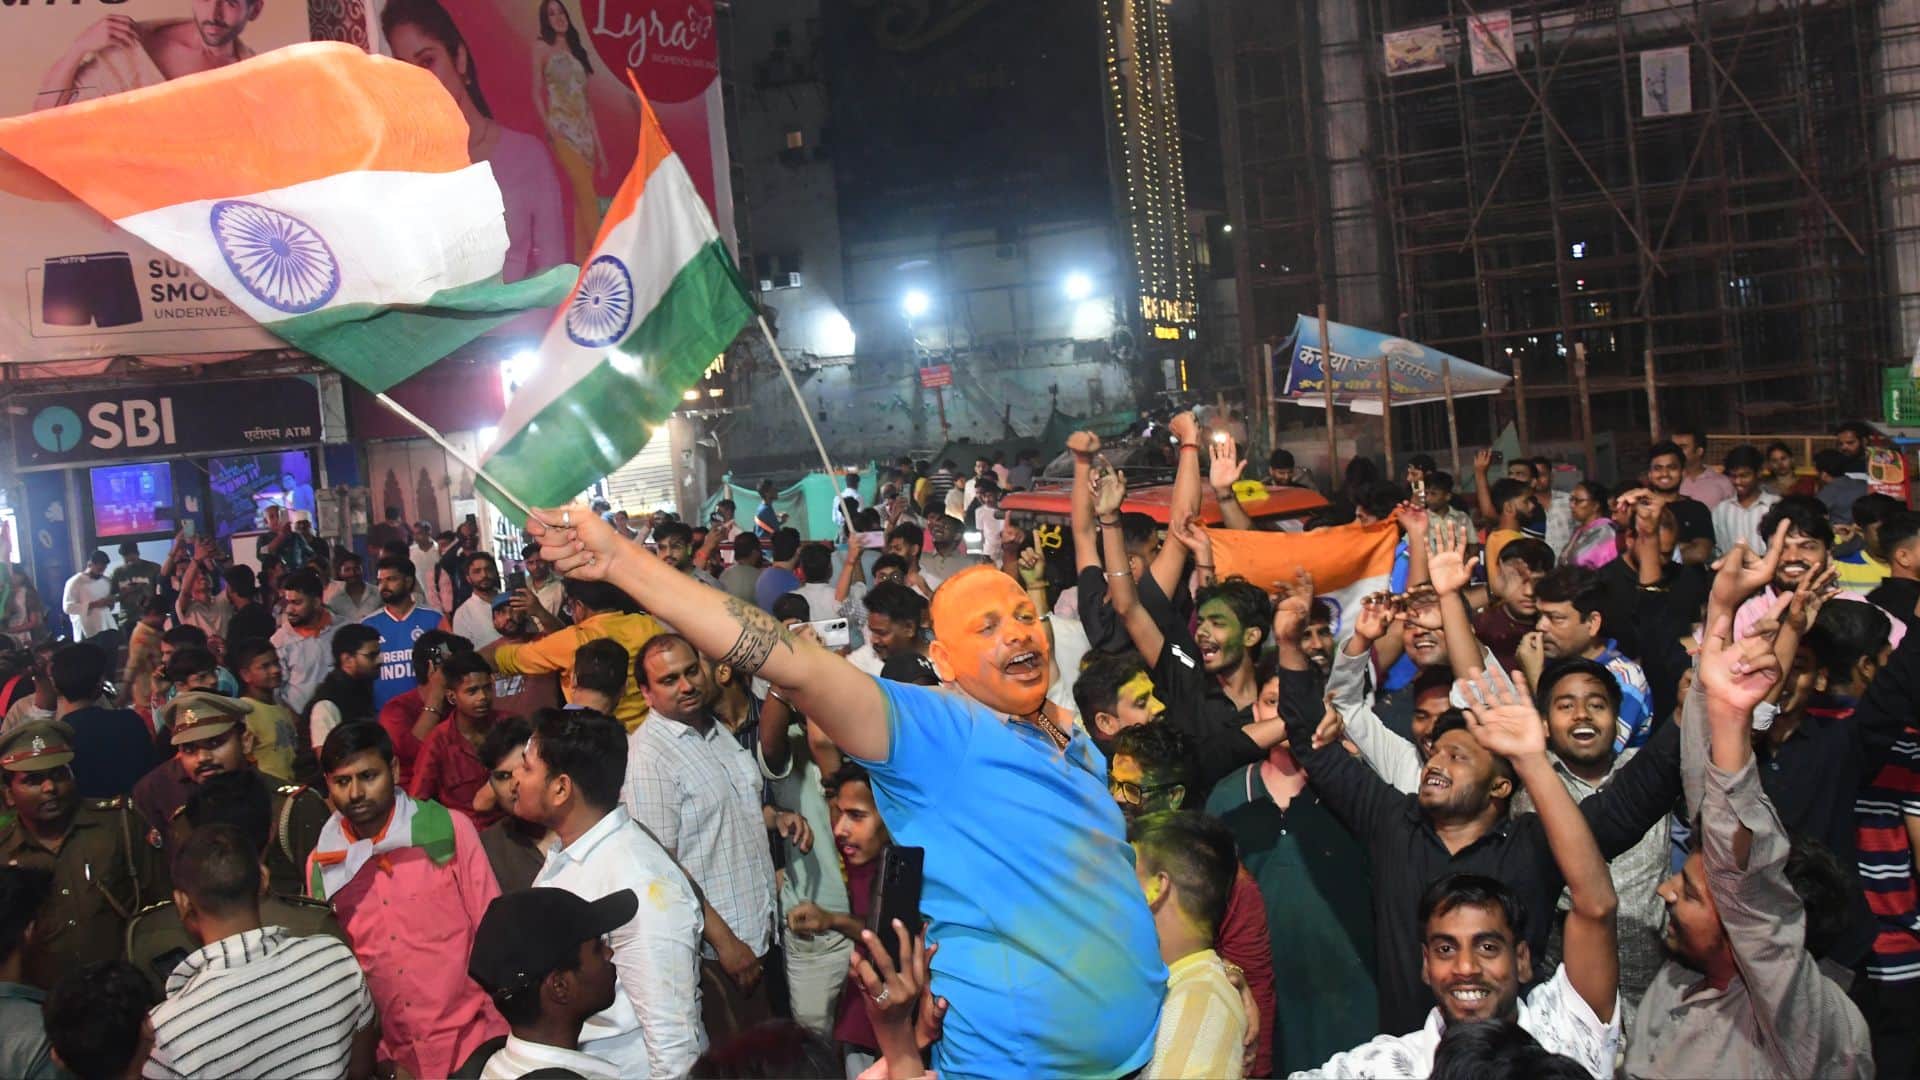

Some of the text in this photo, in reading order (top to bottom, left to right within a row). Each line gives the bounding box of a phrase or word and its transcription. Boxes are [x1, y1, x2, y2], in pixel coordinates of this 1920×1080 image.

[592, 0, 697, 67] Lyra
[89, 397, 176, 449] SBI
[285, 426, 311, 440] ATM
